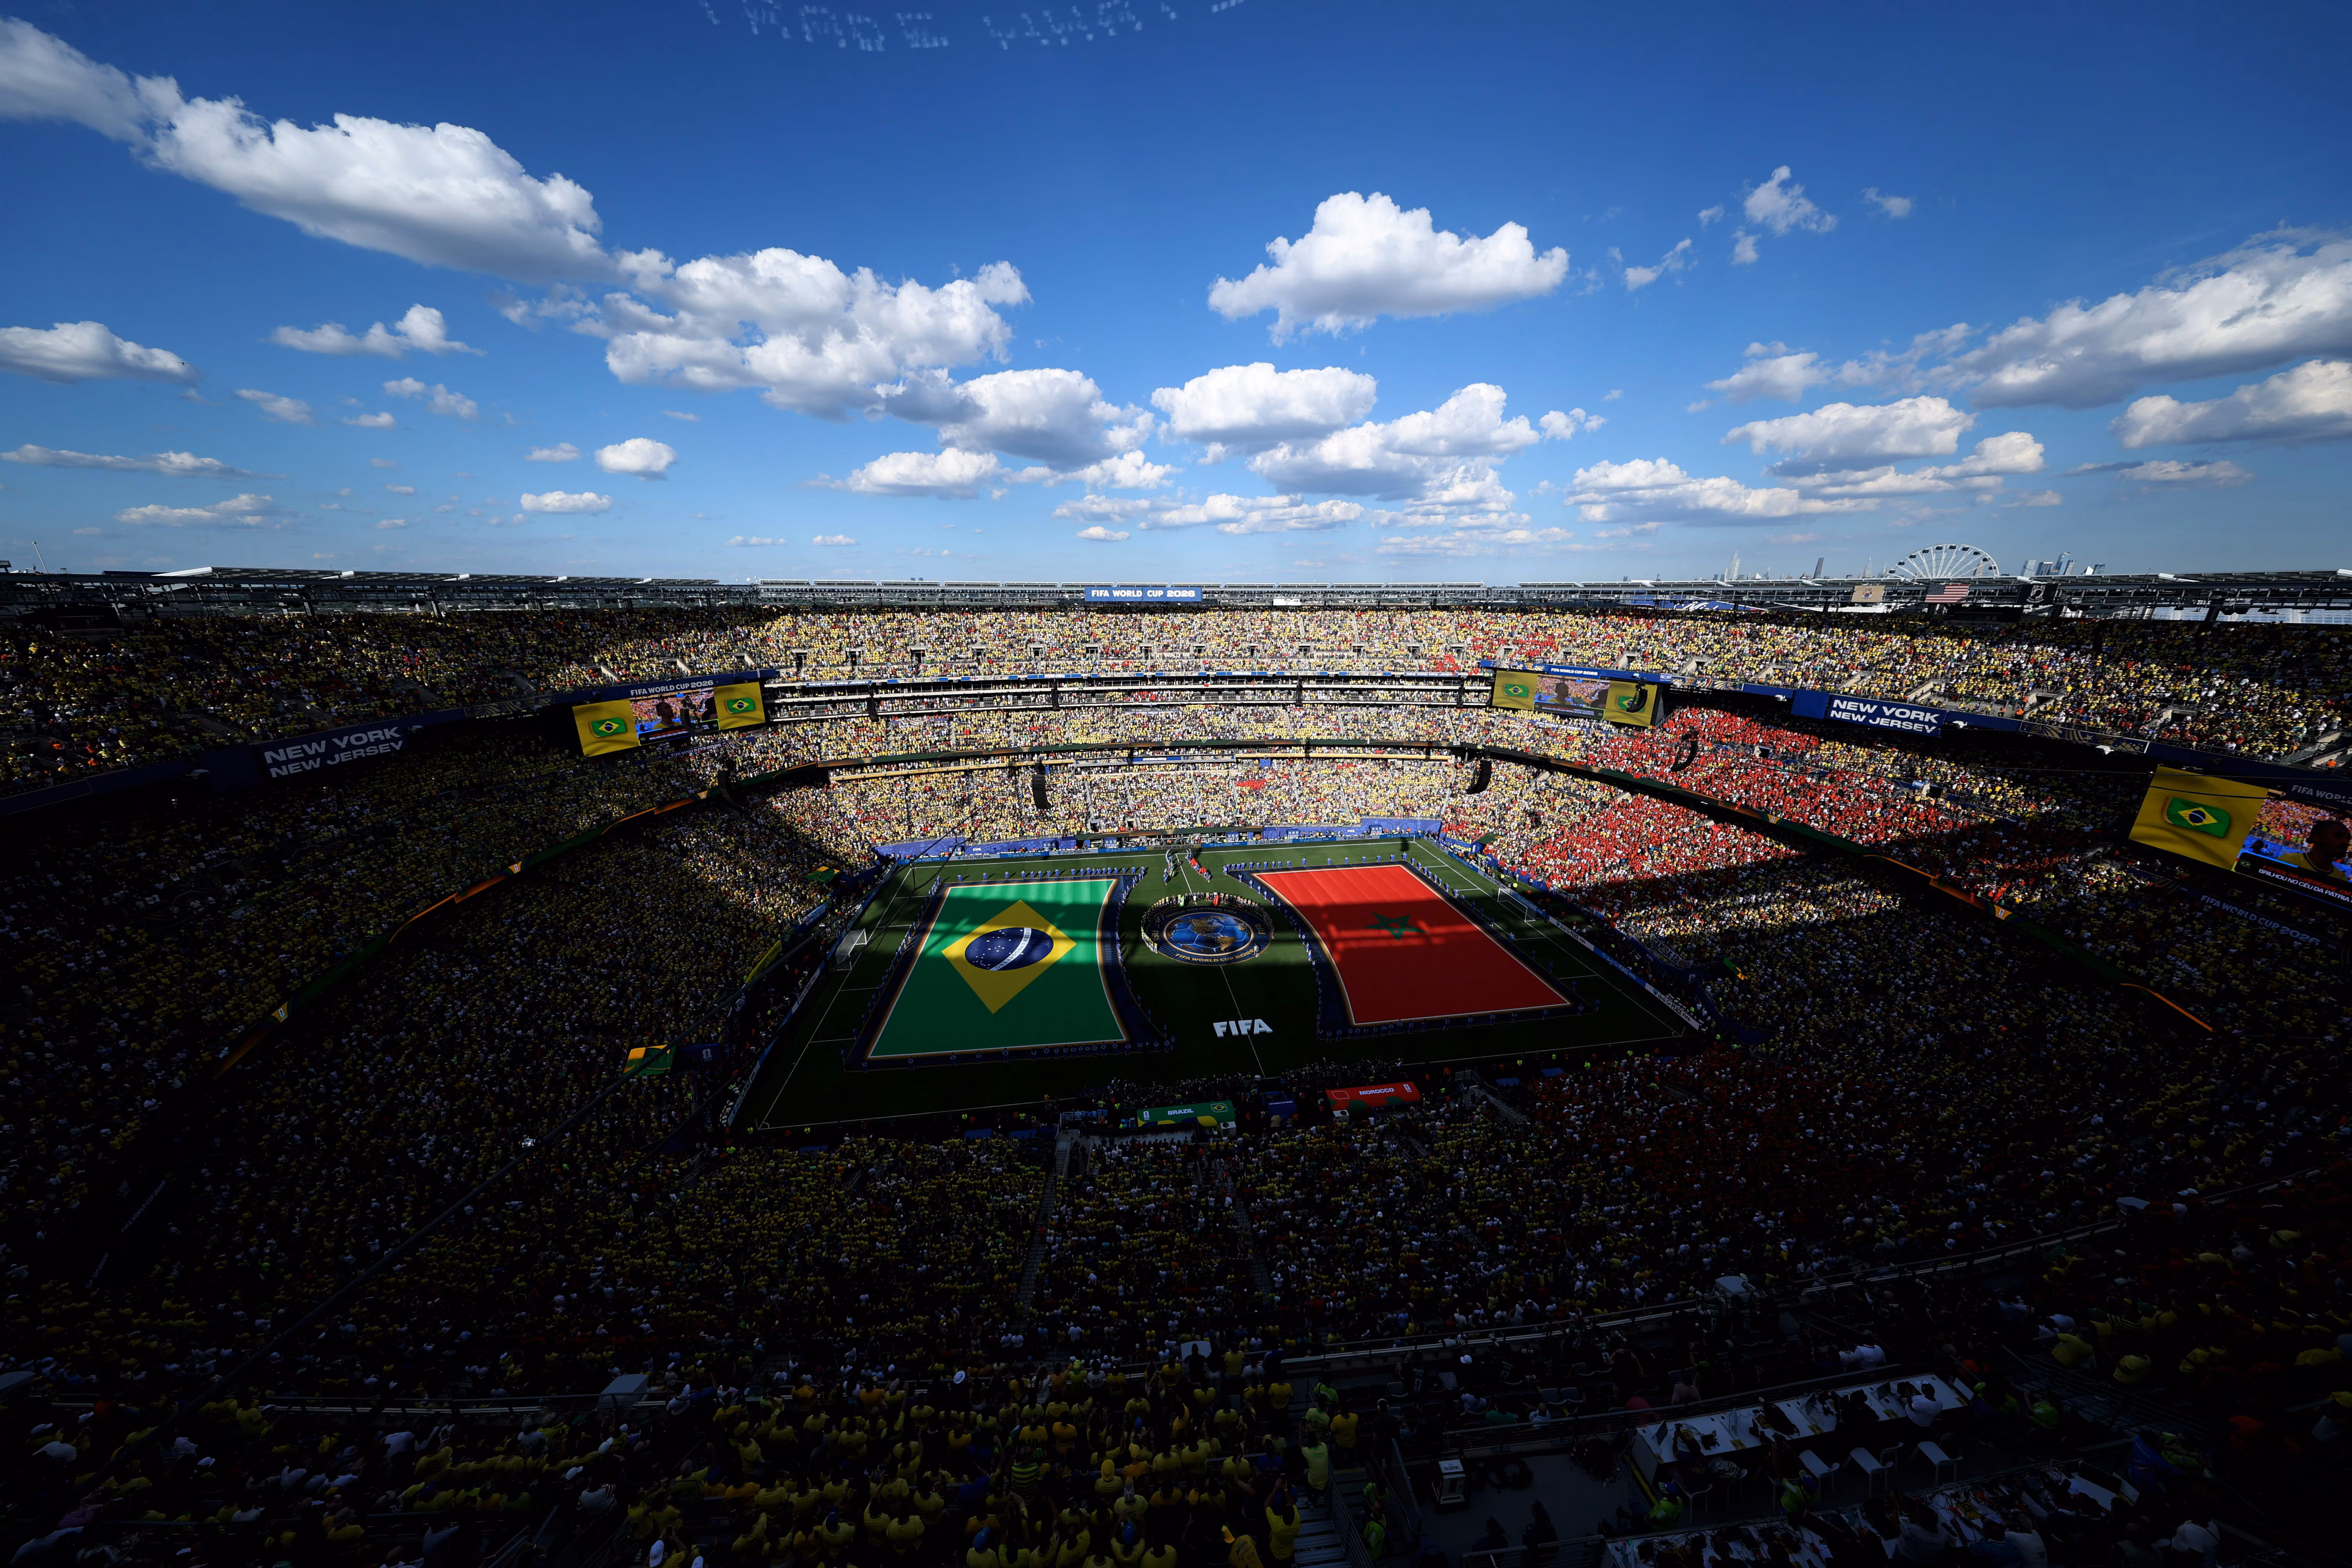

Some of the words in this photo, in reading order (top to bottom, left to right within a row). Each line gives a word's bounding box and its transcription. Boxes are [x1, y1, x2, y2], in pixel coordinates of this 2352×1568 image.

[630, 687, 648, 696] FIFA
[648, 684, 674, 694] WORLD
[674, 682, 690, 691] CUP
[691, 680, 714, 688] 2026
[1830, 710, 1867, 722] NEW
[1869, 717, 1937, 733] JERSEY
[1832, 699, 1878, 714] NEW
[1882, 706, 1941, 724] YORK
[263, 740, 326, 764] NEW
[332, 726, 402, 748] YORK
[270, 757, 321, 778] NEW
[326, 740, 404, 765] JERSEY
[2291, 785, 2313, 796] FIFA
[2258, 869, 2287, 881] BRILHOU
[2298, 881, 2313, 890] CÉU
[2200, 895, 2220, 909] FIFA
[2221, 902, 2258, 922] WORLD
[2258, 916, 2280, 930] CUP
[2279, 925, 2321, 946] 2026
[1570, 930, 1579, 940] PEACE
[995, 946, 1025, 969] PROGRESSO
[1175, 953, 1191, 961] FIFA
[1618, 964, 1628, 975] PEACE
[1671, 1003, 1682, 1015] PEACE
[1213, 1018, 1273, 1038] FIFA
[1359, 1087, 1395, 1096] MOROCCO
[121, 1221, 132, 1233] FIFA
[131, 1203, 147, 1222] WORLD
[146, 1194, 154, 1205] CUP
